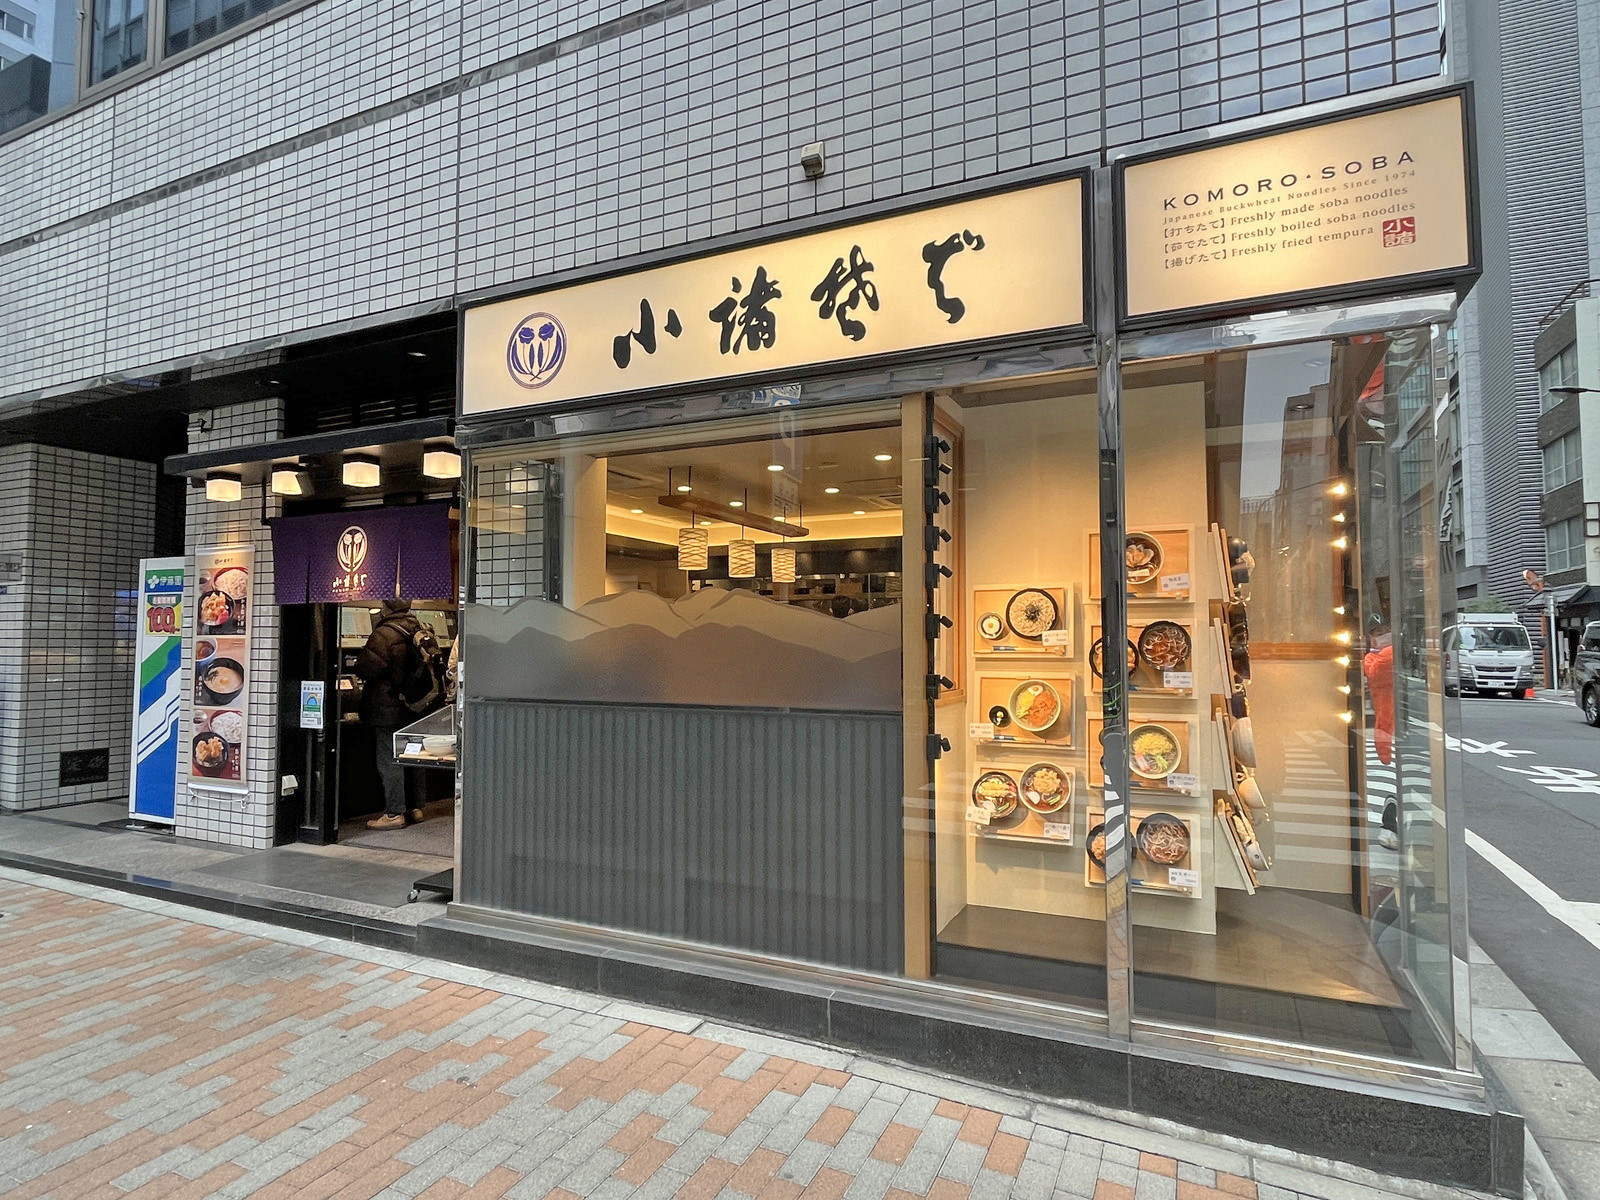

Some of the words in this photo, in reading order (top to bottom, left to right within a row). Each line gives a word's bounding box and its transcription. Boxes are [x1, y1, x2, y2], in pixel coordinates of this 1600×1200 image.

[1163, 209, 1213, 225] Japanese
[1219, 196, 1281, 214] Buckwheat
[1287, 186, 1337, 200] Noodles
[1343, 178, 1377, 190] Since
[1385, 170, 1415, 182] 1974
[1230, 211, 1276, 226] Freshly
[1281, 203, 1315, 216] made
[1320, 198, 1349, 209] soba
[1355, 186, 1408, 203] noodles
[1231, 227, 1276, 241] Freshly
[1281, 218, 1321, 233] boiled
[1327, 213, 1357, 225] soba
[1362, 202, 1415, 218] noodles
[1231, 243, 1277, 257] Freshly
[1281, 235, 1313, 248] fried
[1318, 227, 1374, 243] tempura
